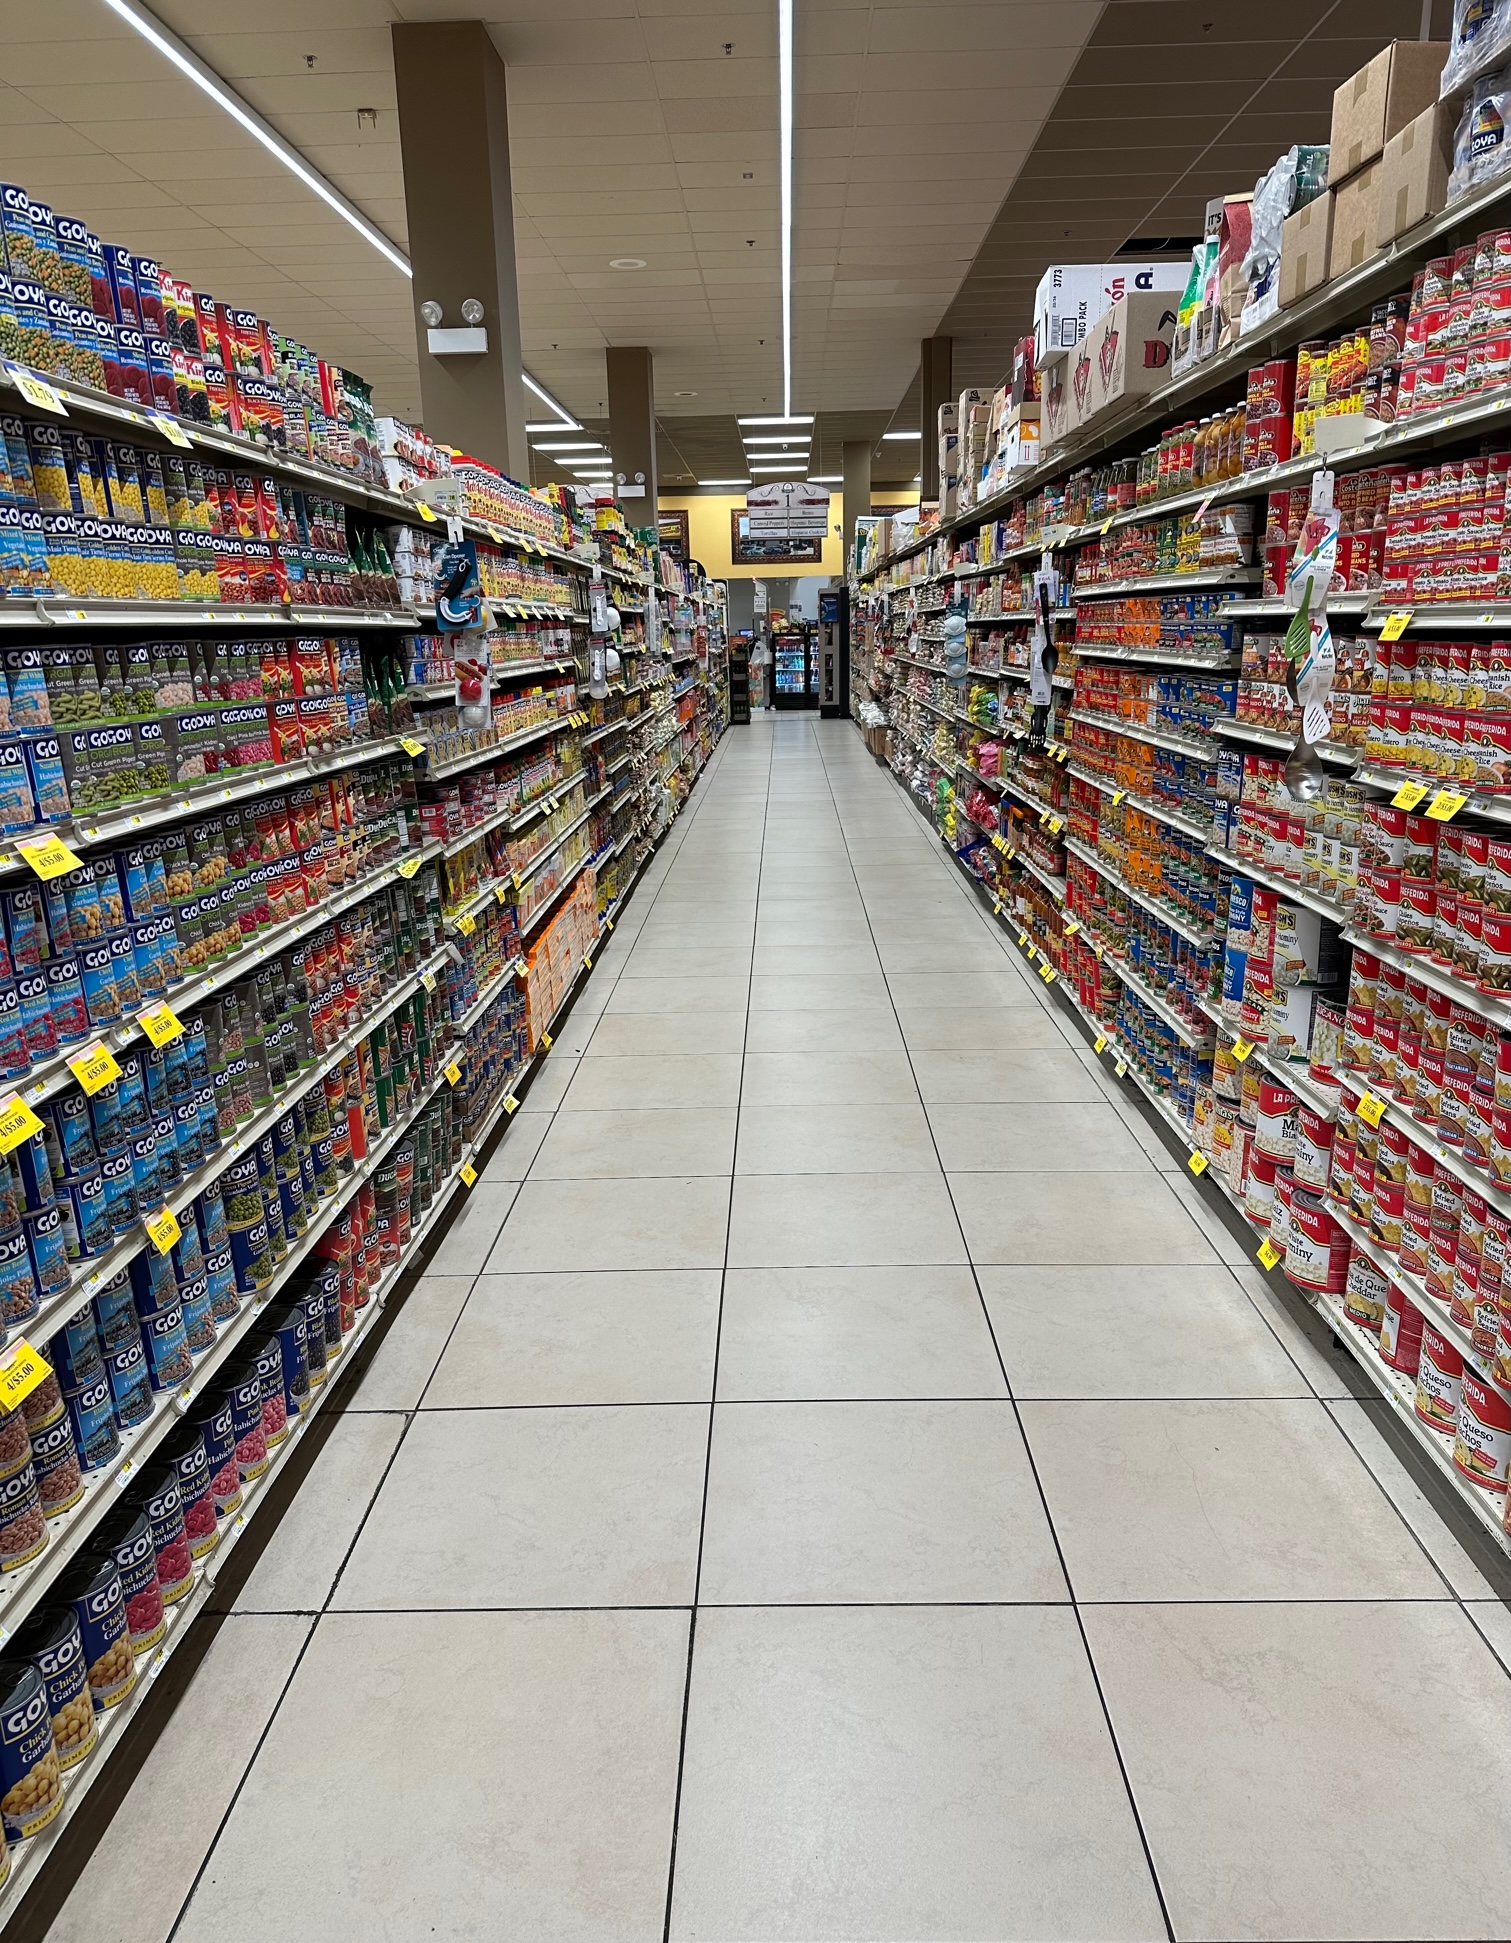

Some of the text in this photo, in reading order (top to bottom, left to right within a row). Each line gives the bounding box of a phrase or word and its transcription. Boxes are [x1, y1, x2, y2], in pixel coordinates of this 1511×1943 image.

[1306, 154, 1314, 174] CAL
[5, 188, 28, 210] GO
[29, 206, 53, 227] OY
[1208, 212, 1221, 226] IT'S
[140, 262, 157, 277] GO
[1053, 269, 1062, 288] 3773
[14, 284, 45, 303] OYA
[1078, 301, 1087, 341] MBO PACK
[246, 383, 267, 396] GOY
[785, 494, 791, 507] 1
[43, 517, 75, 534] GOY
[75, 520, 100, 536] GOY
[101, 524, 127, 538] OYA
[147, 530, 172, 543] OYA
[8, 650, 41, 667] GOY
[41, 651, 69, 664] GOY
[69, 649, 92, 662] GOY
[163, 644, 187, 657] GOY
[109, 730, 132, 743] GOY
[36, 741, 59, 757] GO
[38, 853, 64, 867] 4/$5.00
[95, 857, 115, 874] OY
[1278, 914, 1294, 928] SH'S
[112, 938, 130, 953] GO
[86, 949, 108, 967] GO
[50, 961, 78, 981] GOY
[20, 975, 46, 996] GOY
[154, 1020, 172, 1035] 4/$5.00
[87, 1062, 108, 1080] 4/$5.00
[227, 1061, 247, 1075] GOY
[1274, 1093, 1283, 1102] LA
[178, 1101, 196, 1119] GO
[1282, 1130, 1297, 1139] Bla
[103, 1155, 130, 1176] GOY
[221, 1161, 256, 1182] GOYA
[157, 1223, 174, 1242] 4/$5.00
[0, 1234, 26, 1259] OYA
[207, 1250, 231, 1270] GOY
[181, 1281, 208, 1300] GOY
[1348, 1283, 1377, 1300] heddar
[1366, 1279, 1386, 1294] Que
[1478, 1284, 1499, 1301] PREFE
[155, 1307, 182, 1331] GOY
[1478, 1311, 1498, 1326] Refrie
[1423, 1329, 1444, 1355] FERIDA
[116, 1345, 144, 1370] GOY
[259, 1351, 282, 1370] OYA
[7, 1362, 35, 1392] 4/$5.00
[1424, 1372, 1452, 1389] Queso
[238, 1382, 259, 1403] GO
[1462, 1376, 1485, 1406] FERIDA
[1462, 1418, 1493, 1443] Queso
[180, 1449, 204, 1474] GO
[150, 1486, 180, 1519] GOY
[117, 1534, 152, 1565] GOY
[92, 1580, 120, 1613] GO
[39, 1630, 81, 1672] GOY
[50, 1674, 76, 1694] Chick
[8, 1690, 47, 1733] GOY
